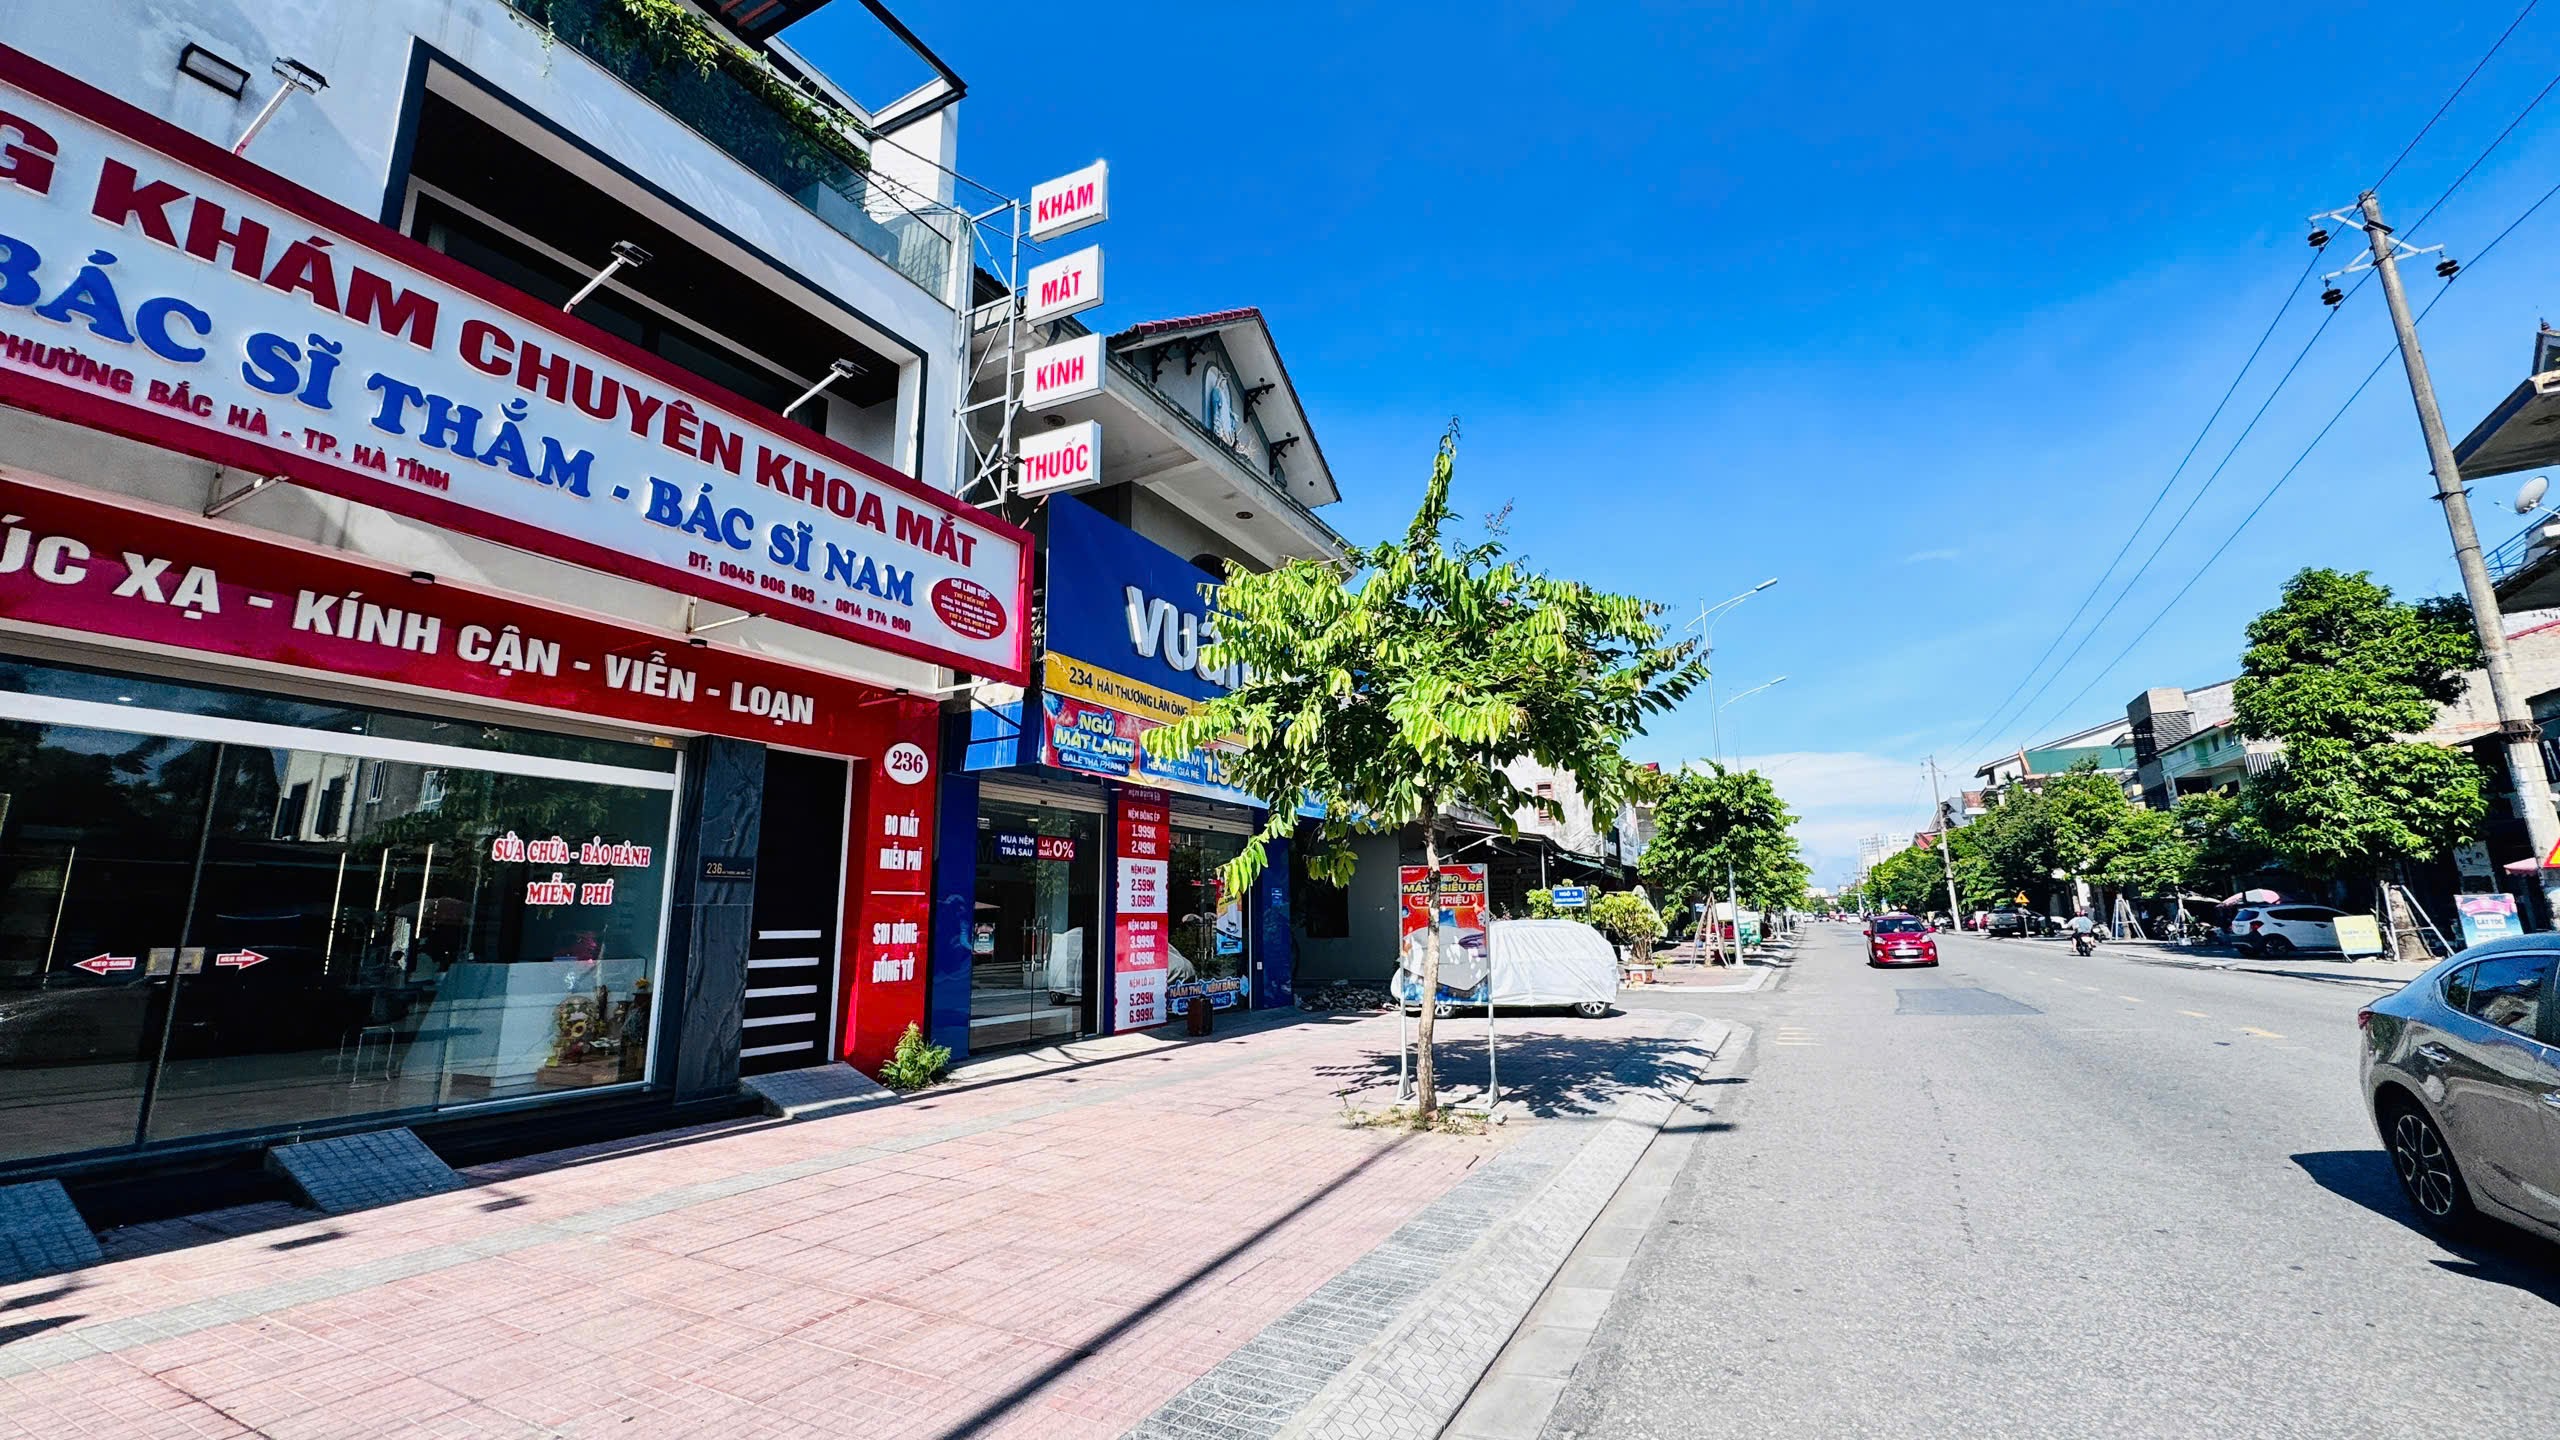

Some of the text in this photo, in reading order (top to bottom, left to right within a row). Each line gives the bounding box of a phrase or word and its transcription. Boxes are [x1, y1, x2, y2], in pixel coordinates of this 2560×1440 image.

[1037, 183, 1094, 224] KHÁM
[1041, 265, 1083, 308] MẮT
[91, 156, 440, 351] KHÁM
[459, 319, 743, 474] CHUYÊN
[756, 445, 887, 534] KHOA
[896, 504, 977, 568] MẮT
[1036, 356, 1085, 393] KÍNH
[0, 233, 212, 363] BÁC
[241, 331, 343, 410] SĨ
[366, 372, 595, 498] THẮM
[644, 476, 754, 550] BÁC
[768, 521, 813, 572] SĨ
[824, 542, 914, 606] NAM
[147, 379, 214, 417] BẮC
[227, 404, 268, 436] HÀ
[304, 427, 341, 458] TP.
[352, 443, 387, 473] HÀ
[396, 456, 449, 491] TĨNH
[1023, 437, 1089, 483] THUỐC
[688, 551, 712, 571] ĐT:
[719, 562, 755, 585] 0945
[760, 574, 785, 594] 606
[791, 584, 815, 603] 693
[835, 598, 862, 617] 0914
[112, 551, 220, 620] XẠ
[291, 590, 441, 654] KÍNH
[456, 624, 561, 677] CẬN
[604, 650, 697, 703] VIỄN
[730, 681, 814, 726] LOẠN
[1069, 666, 1093, 689] 234
[1096, 677, 1114, 696] HẢI
[1115, 685, 1154, 708] THƯỢNG
[1080, 714, 1113, 735] NGỦ
[1092, 736, 1133, 759] LẠNH
[891, 750, 924, 774] 236
[1062, 753, 1084, 764] SALE
[1100, 760, 1126, 772] PHANH
[900, 809, 920, 838] MẮT
[1131, 824, 1157, 840] 1.999K
[493, 831, 525, 861] SỬA
[527, 837, 569, 863] CHỮA
[580, 836, 610, 865] BẢO
[611, 841, 651, 867] HÀNH
[1000, 834, 1035, 847] MUA NỆM
[1001, 844, 1033, 857] TRẢ SAU
[1053, 840, 1074, 858] 0%
[1131, 840, 1156, 855] 2.499K
[880, 841, 923, 871] MIỄN PHÍ
[706, 862, 723, 874] 236
[526, 873, 614, 905] MIỄN PHÍ
[1131, 879, 1156, 892] 2.599K
[1403, 880, 1484, 893] MÁT SIÊU RẺ
[1440, 894, 1470, 906] TRIỆU
[872, 918, 918, 945] SOI BÓNG
[1130, 935, 1156, 950] 3.999K
[1129, 951, 1155, 966] 4.999K
[1129, 992, 1154, 1007] 5.299K
[1129, 1007, 1154, 1024] 6.999K
